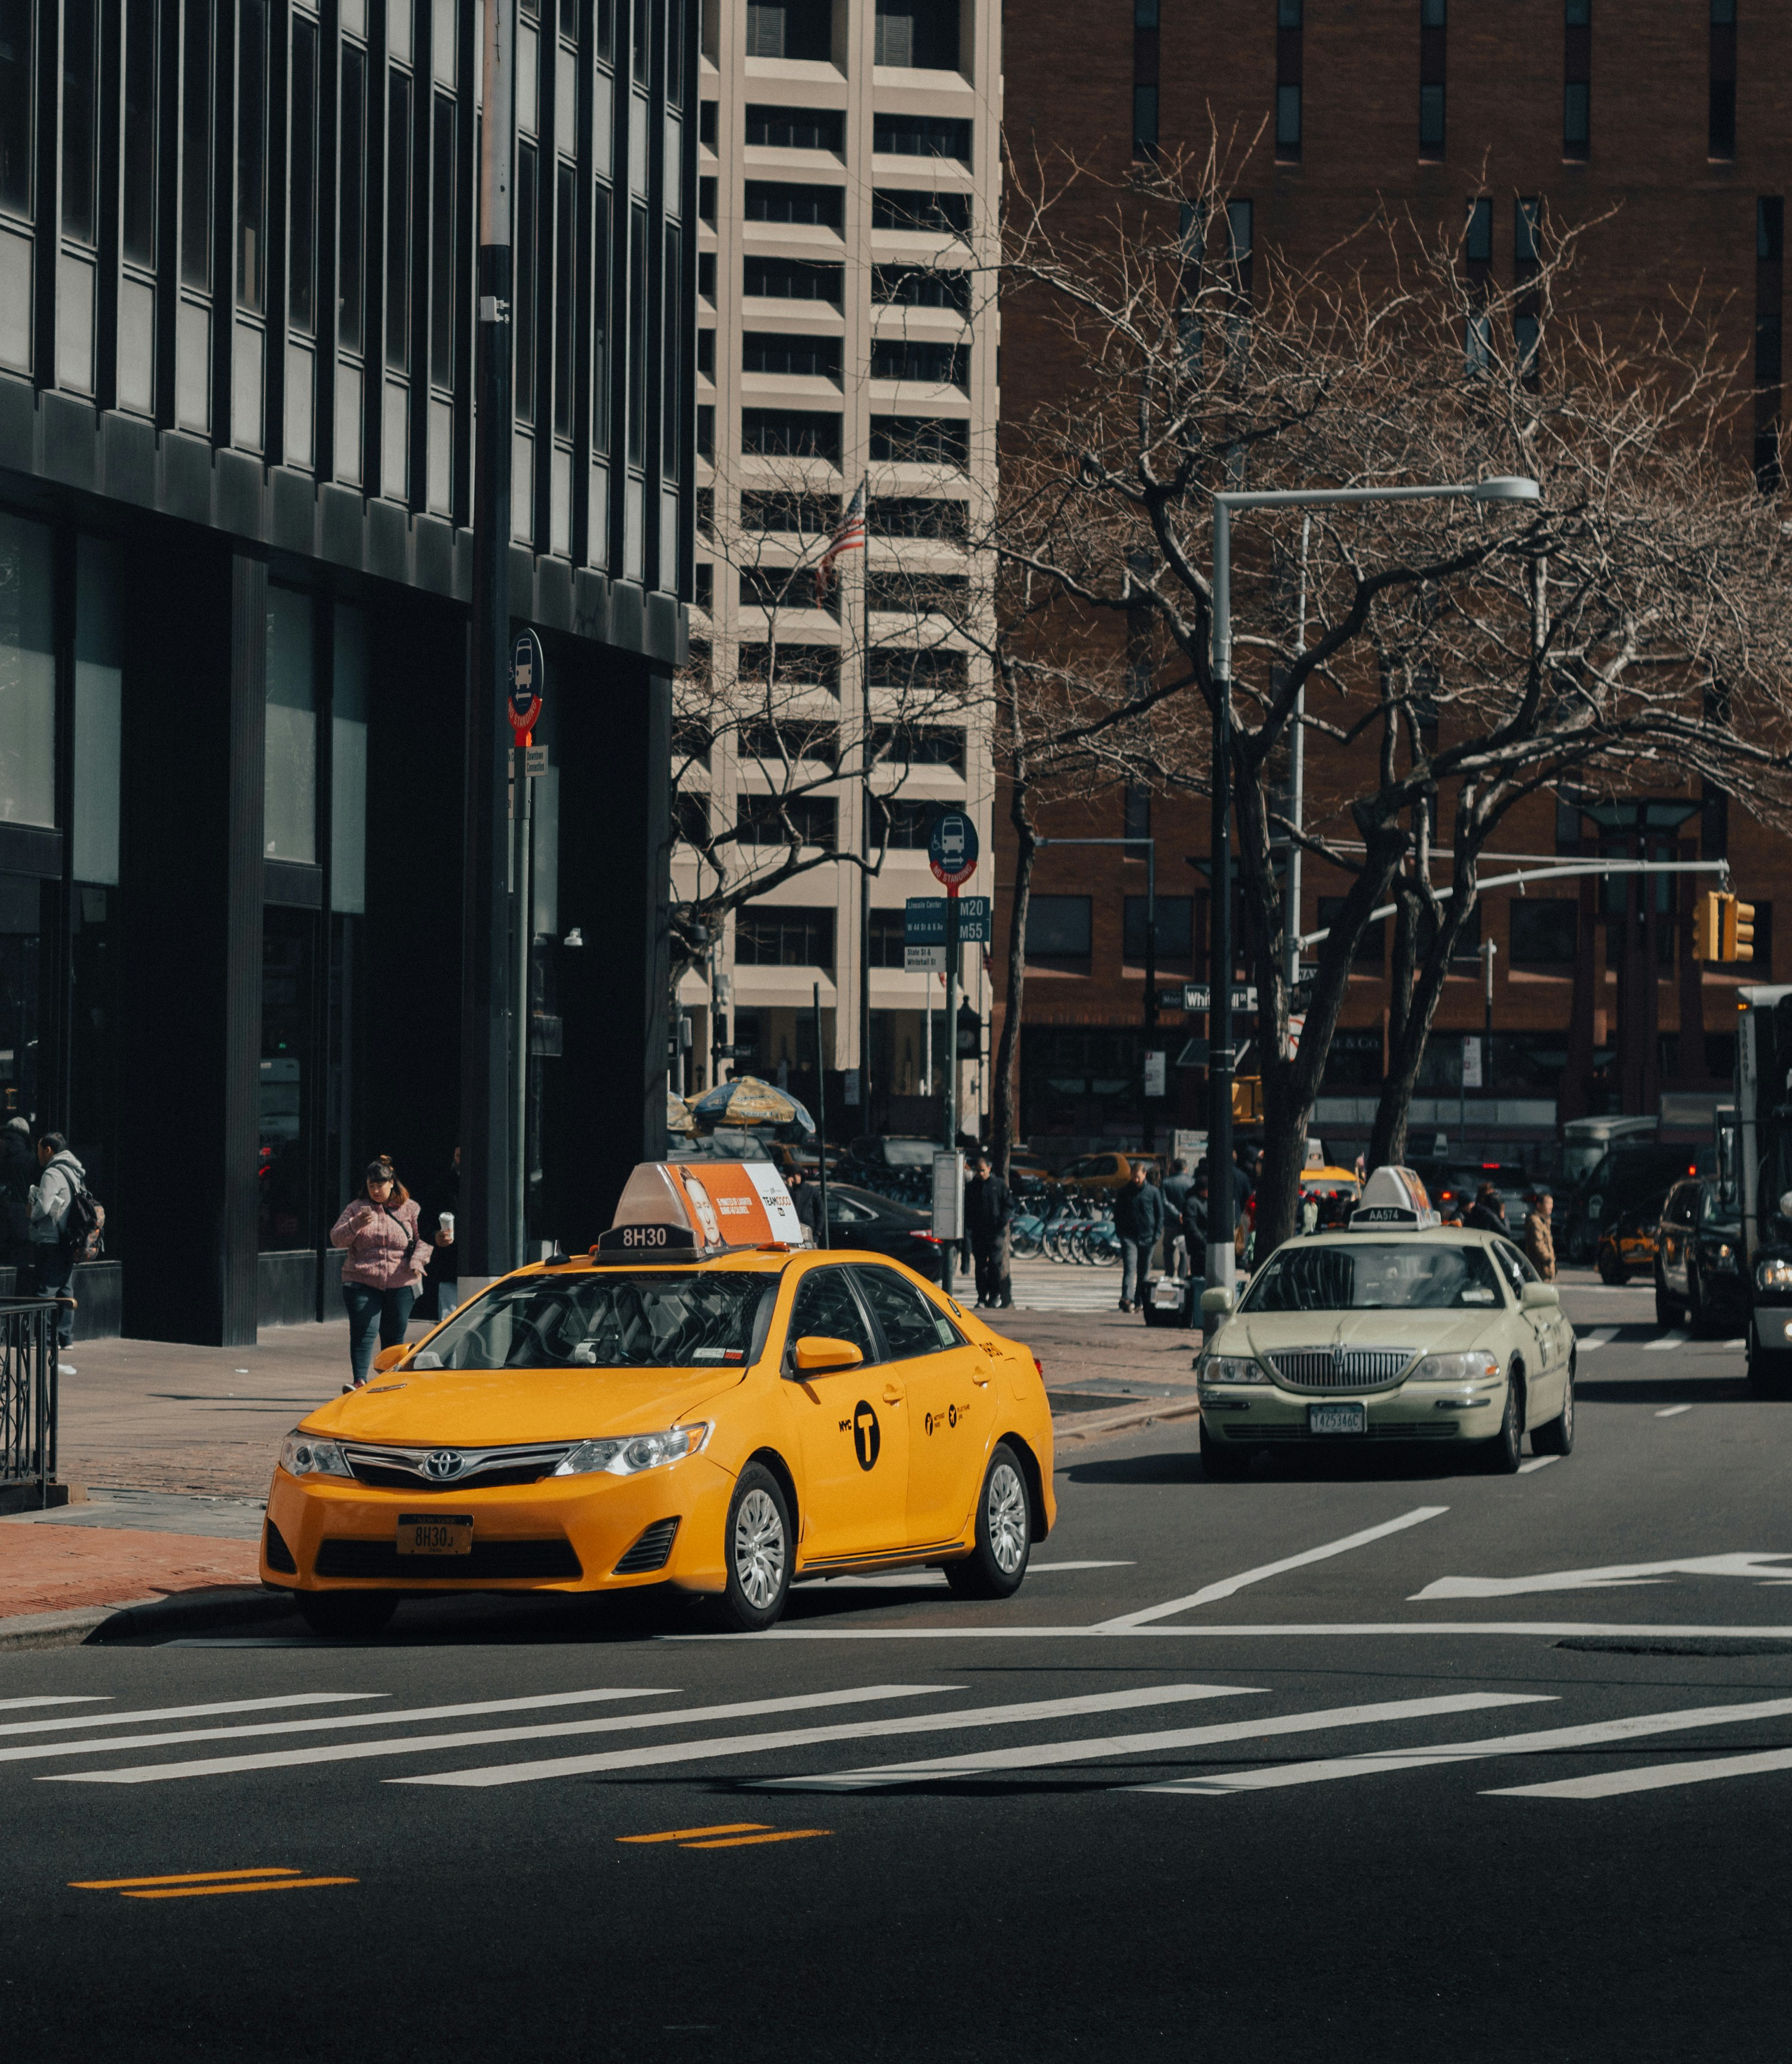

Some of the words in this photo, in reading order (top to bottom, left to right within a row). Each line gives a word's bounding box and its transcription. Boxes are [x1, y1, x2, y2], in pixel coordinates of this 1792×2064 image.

[514, 699, 536, 727] STANDING
[527, 751, 543, 761] Downtown
[527, 762, 545, 772] Connection
[933, 865, 942, 878] NO
[943, 863, 972, 883] STANDING
[908, 901, 925, 909] Lincoln
[960, 899, 983, 916] M20
[960, 923, 983, 939] M55
[1369, 1209, 1398, 1221] AA574
[623, 1228, 666, 1246] 8H30
[838, 1419, 852, 1432] NYC
[1314, 1414, 1358, 1427] T425346C
[857, 1413, 874, 1463] T
